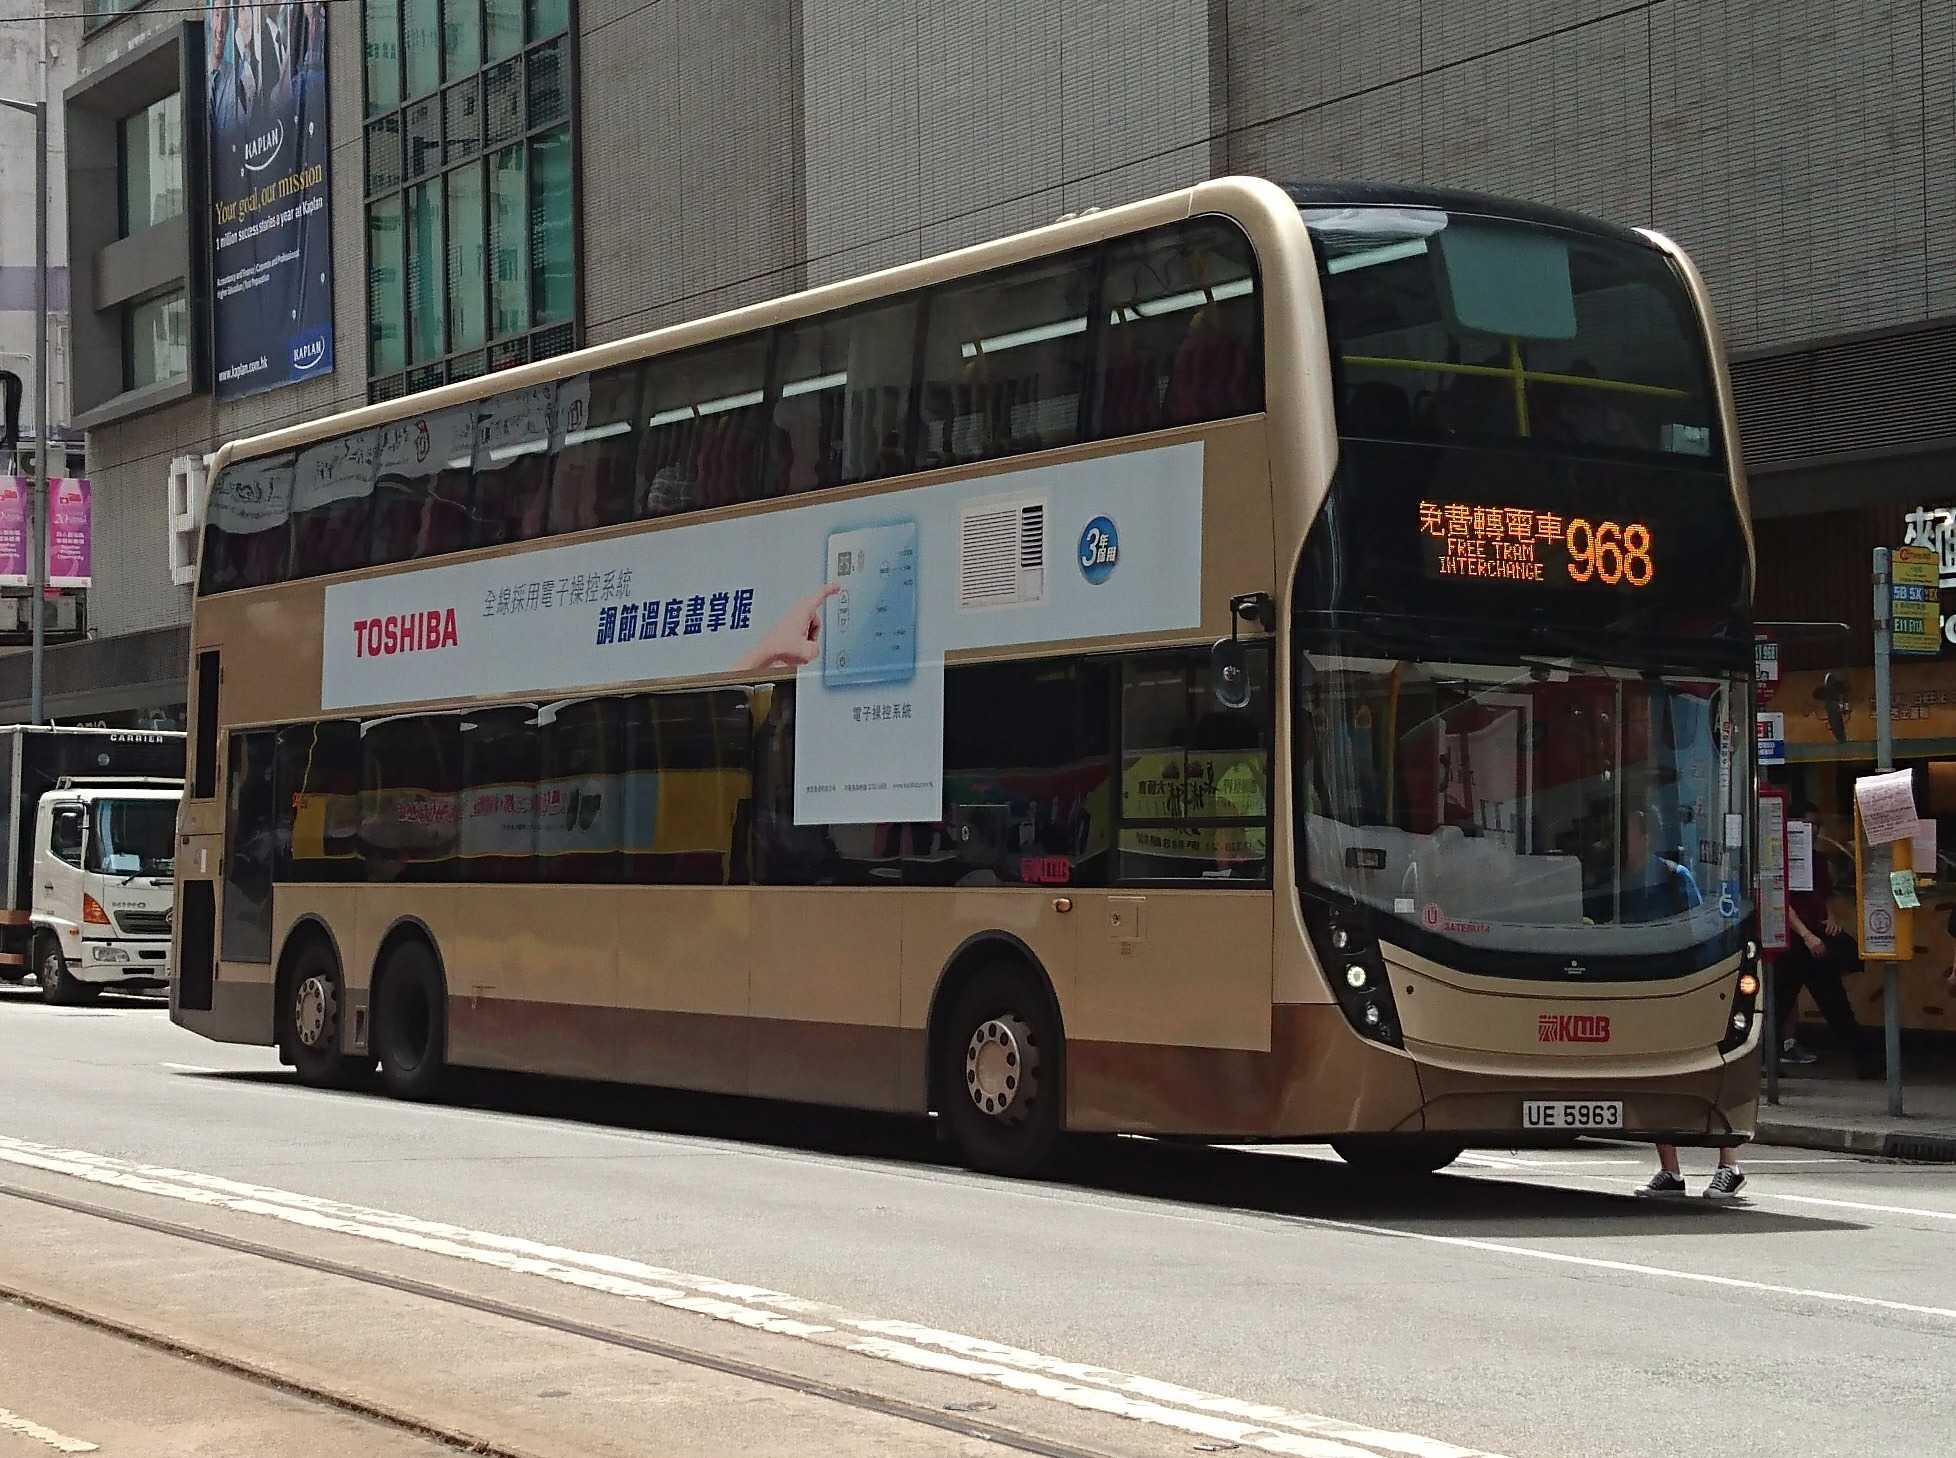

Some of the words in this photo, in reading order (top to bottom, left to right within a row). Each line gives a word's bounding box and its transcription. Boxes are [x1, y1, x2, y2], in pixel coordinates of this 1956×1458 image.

[245, 128, 279, 160] KAPLAN
[216, 201, 237, 224] Your
[240, 187, 261, 223] goal,
[261, 183, 277, 206] our
[279, 164, 322, 198] mission
[238, 225, 259, 241] success
[259, 215, 276, 233] stories
[280, 207, 294, 228] year
[295, 204, 302, 218] at
[302, 196, 323, 216] Kaplan
[294, 341, 321, 361] KAPLAN
[219, 355, 268, 381] www.kaplan.com.hk
[1447, 538, 1486, 558] FREE
[1491, 541, 1534, 561] TRAM
[1566, 518, 1653, 586] 968
[1438, 556, 1544, 581] INTERCHANGE
[597, 588, 754, 645] 調節溫度盡掌握
[353, 608, 458, 657] TOSHIBA
[110, 734, 163, 743] CARRIER
[1559, 1015, 1611, 1043] KMB
[1528, 1105, 1555, 1126] UE
[1564, 1104, 1618, 1126] 5963
